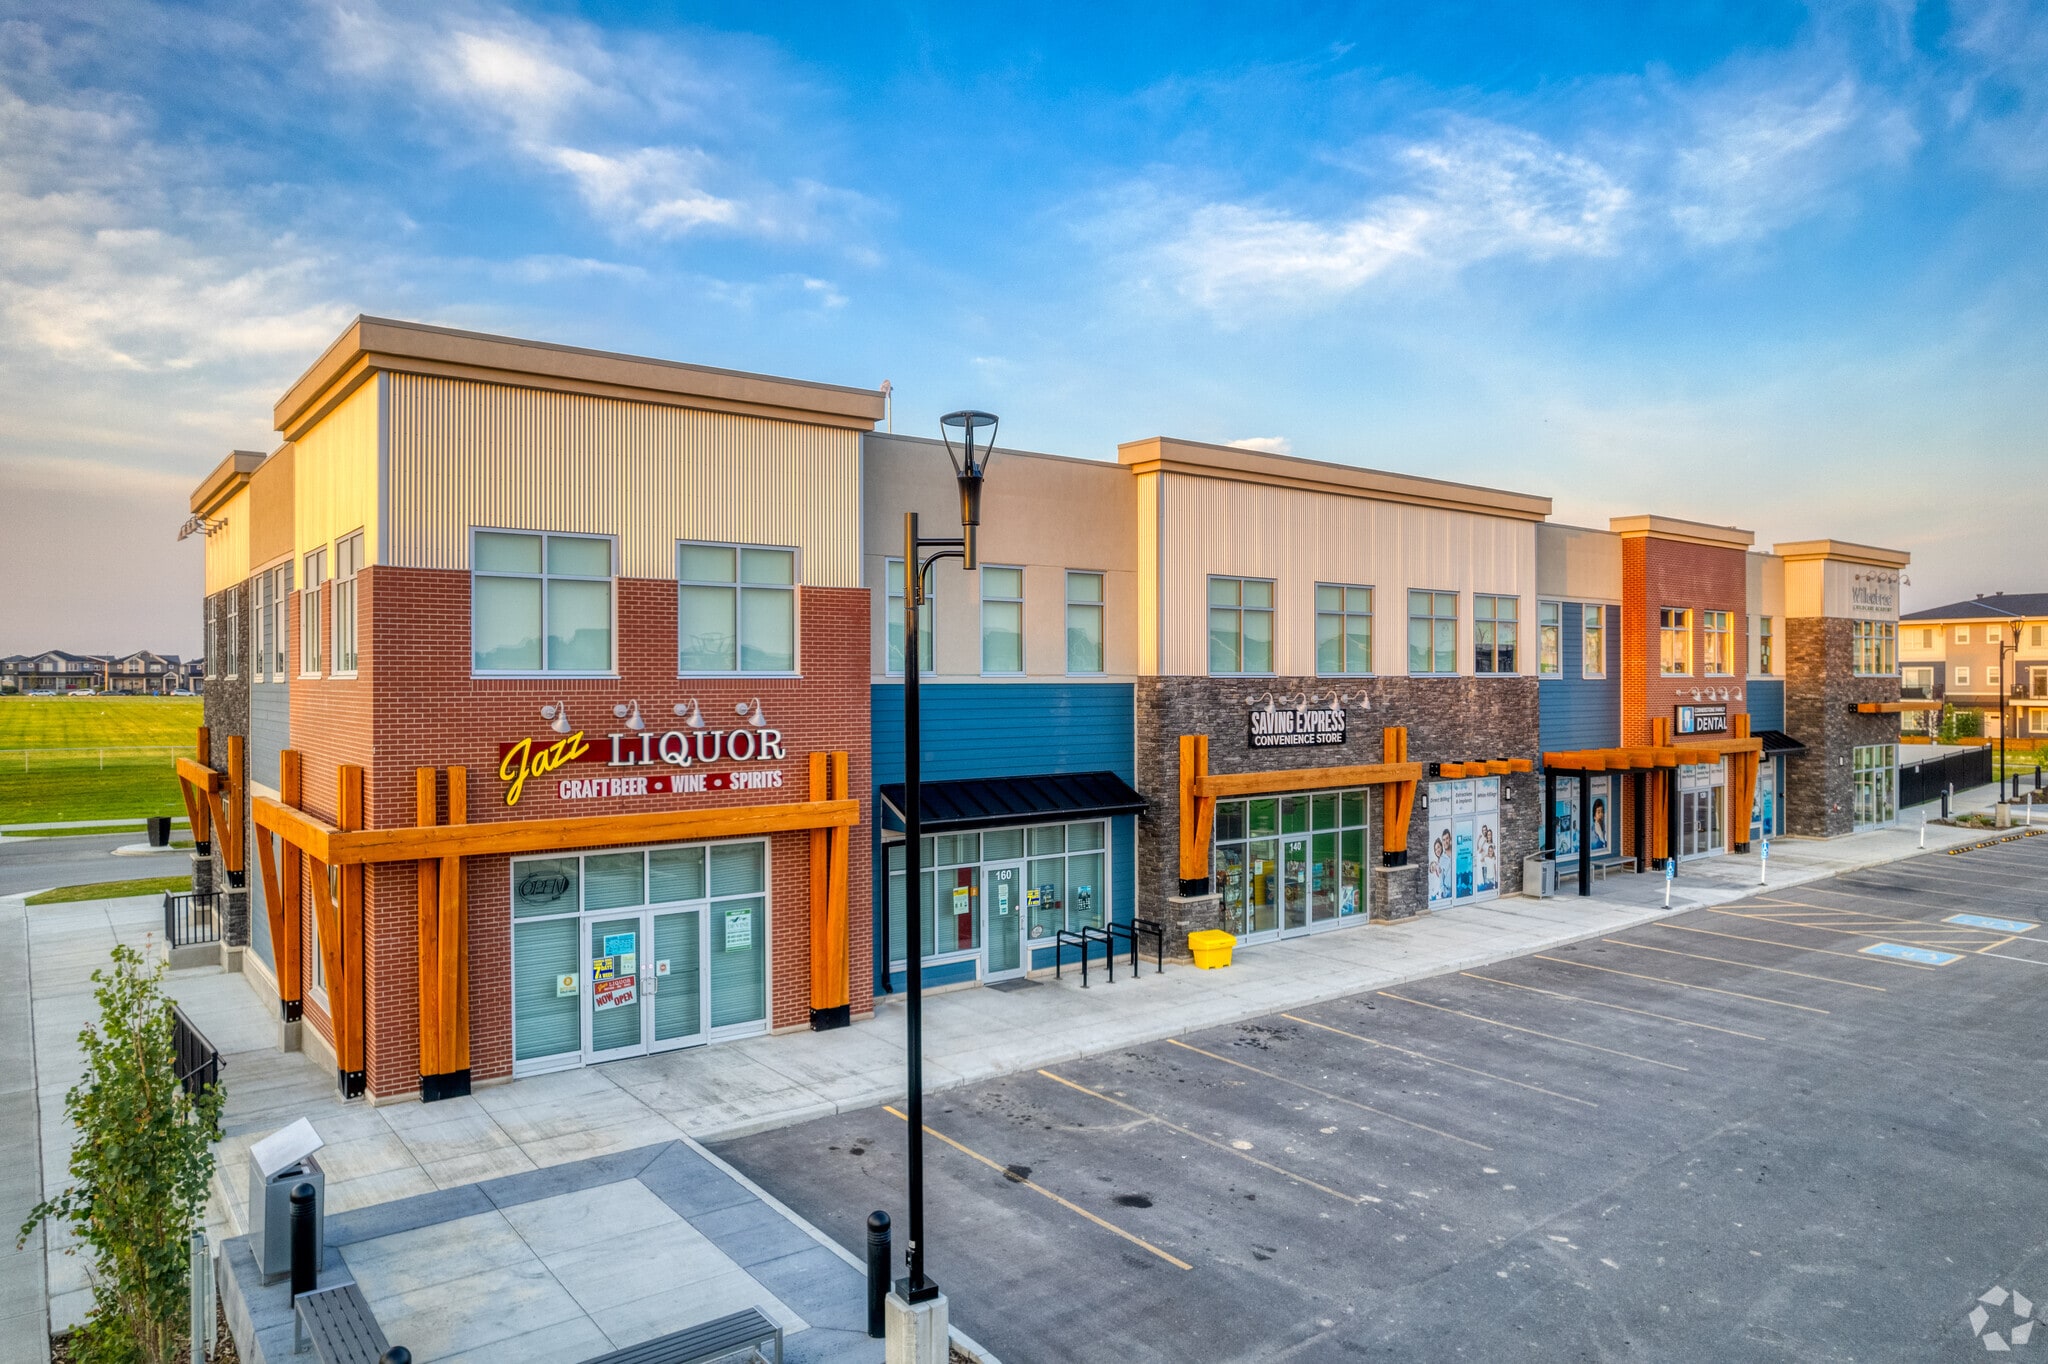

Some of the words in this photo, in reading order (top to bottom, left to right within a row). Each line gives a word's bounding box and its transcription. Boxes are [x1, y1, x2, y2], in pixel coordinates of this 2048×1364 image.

[1251, 711, 1294, 735] SAVING
[1296, 710, 1345, 733] EXPRESS
[1697, 716, 1727, 731] DENTAL
[1254, 734, 1315, 746] CONVENIENCE
[1316, 733, 1343, 743] STORE
[499, 730, 590, 806] Jazz
[607, 728, 786, 768] LIQUOR
[559, 779, 610, 800] CRAFT
[610, 777, 648, 796] BEER
[670, 774, 707, 793] WINE
[729, 770, 783, 790] SPIRITS
[1289, 842, 1301, 851] 140
[996, 870, 1011, 880] 160
[596, 991, 614, 1007] NOW
[614, 991, 633, 1006] OPEN
